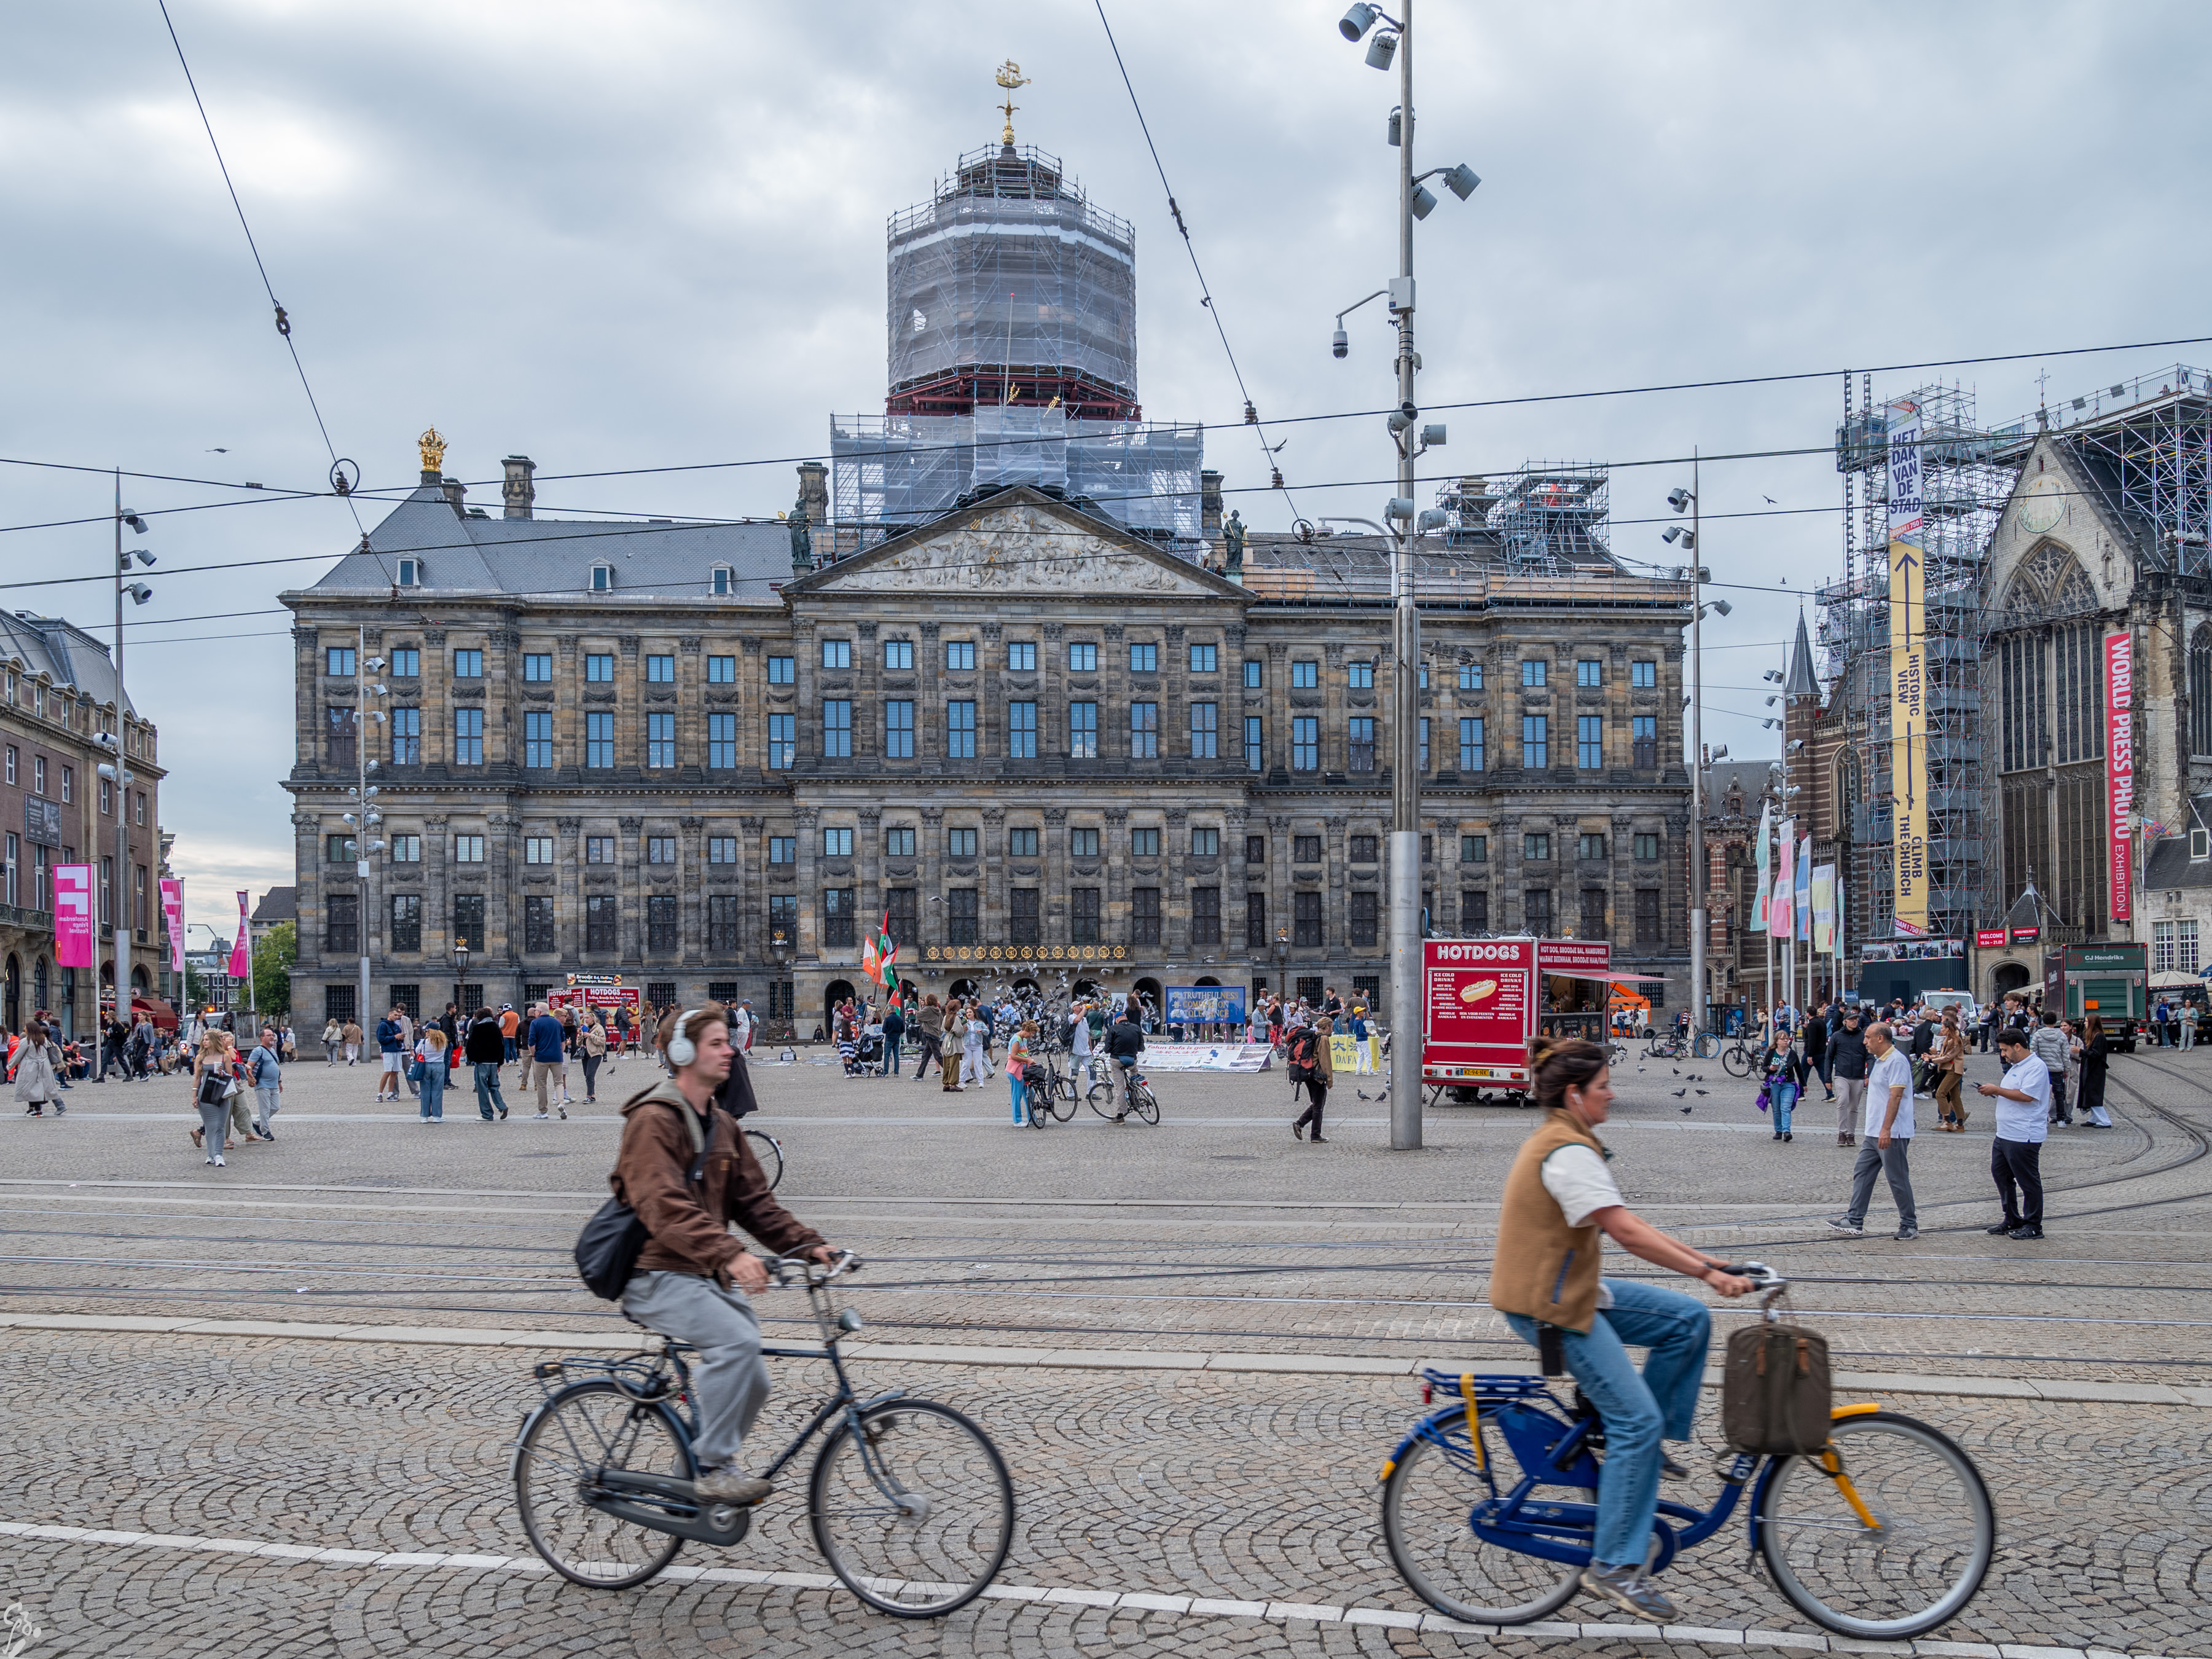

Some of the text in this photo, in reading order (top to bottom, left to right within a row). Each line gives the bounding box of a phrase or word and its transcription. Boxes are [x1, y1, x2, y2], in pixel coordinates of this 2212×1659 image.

[1893, 428, 1916, 448] HET
[1892, 445, 1916, 466] DAK
[1892, 460, 1918, 483] VAN
[1897, 479, 1913, 497] DE
[1890, 497, 1921, 514] STAD
[1910, 520, 1919, 528] 750
[2111, 639, 2130, 708] WORLD
[1898, 670, 1908, 704] VIEW
[1909, 654, 1920, 716] HISTORIC
[2113, 713, 2132, 772] PRESS
[1900, 815, 1911, 896] THE CHURCH
[1912, 836, 1922, 878] CLIMB
[2115, 844, 2126, 912] EXHIBITION
[1909, 925, 1918, 934] 750
[1437, 945, 1520, 960] HOTDOGS
[1336, 1054, 1357, 1064] DAFA
